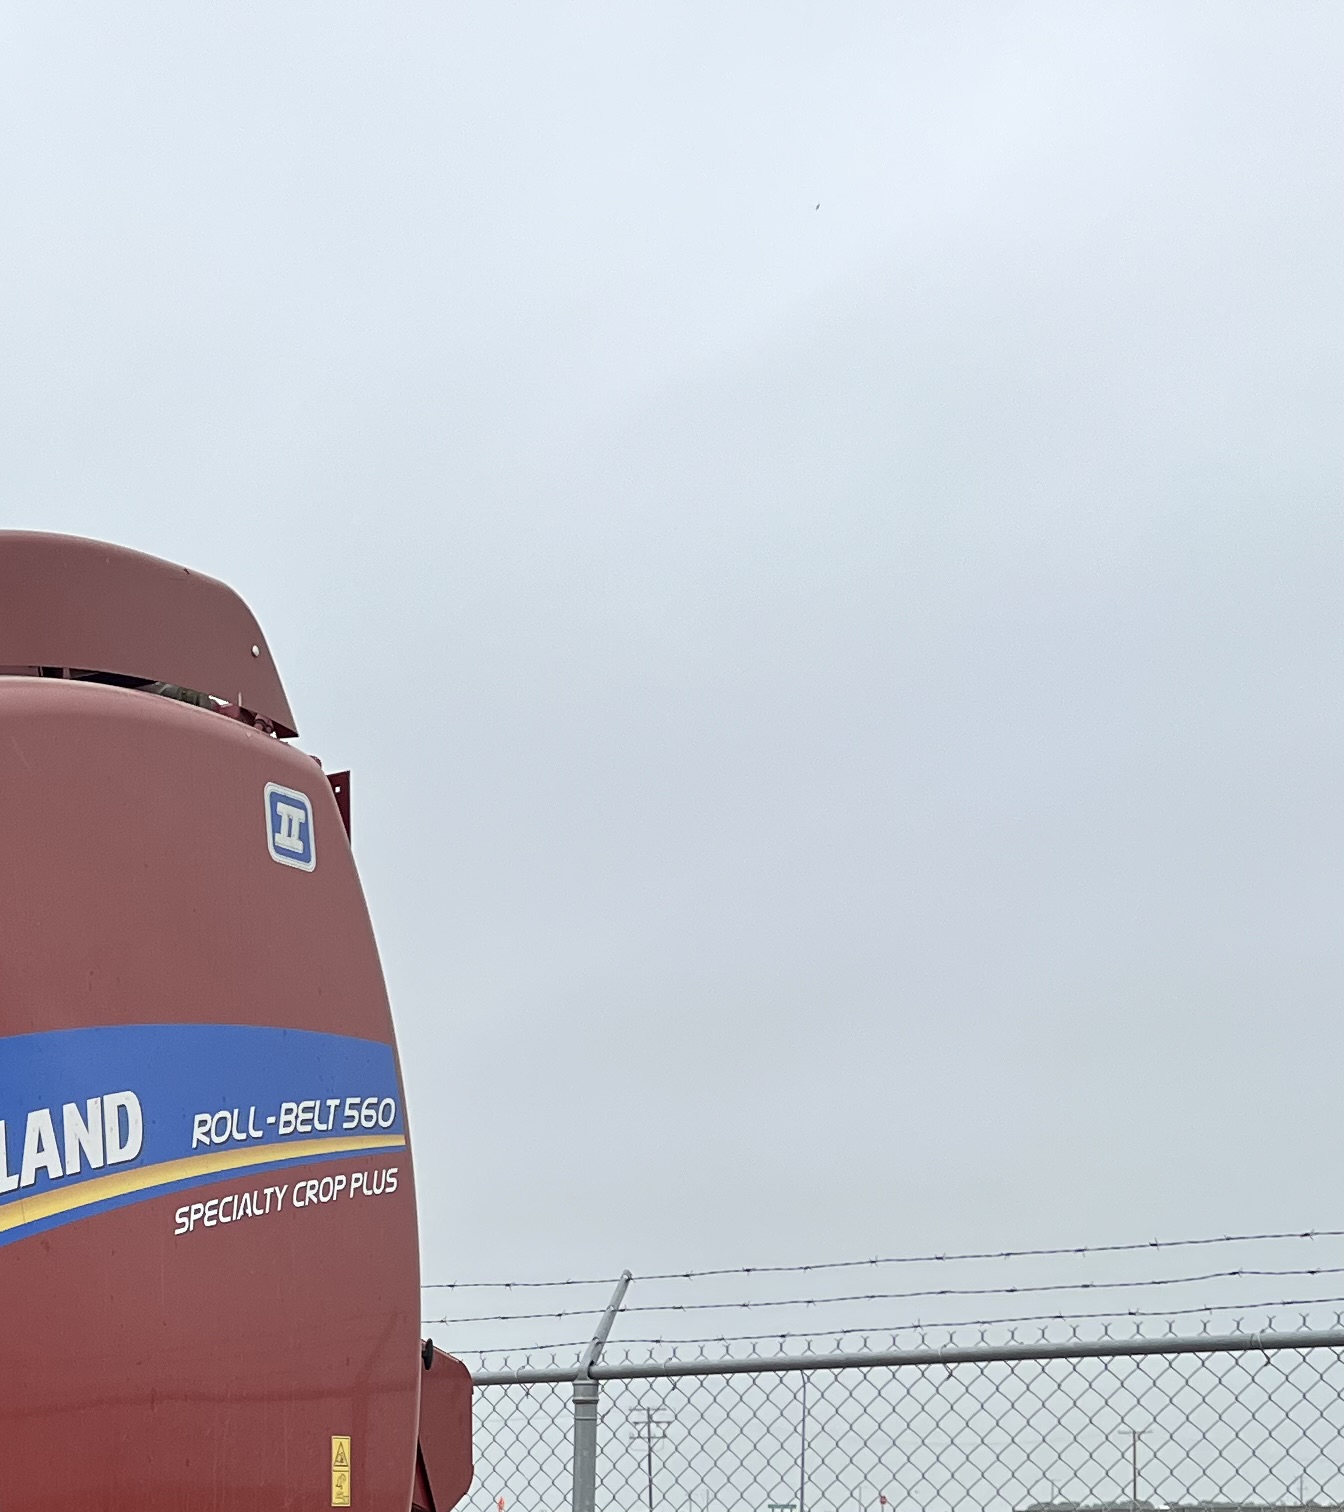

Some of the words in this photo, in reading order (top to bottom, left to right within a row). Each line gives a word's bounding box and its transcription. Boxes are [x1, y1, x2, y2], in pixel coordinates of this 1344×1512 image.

[342, 1097, 396, 1130] 560
[174, 1184, 289, 1236] SPECIALTY
[292, 1174, 347, 1209] CROP
[349, 1167, 399, 1199] PLUS
